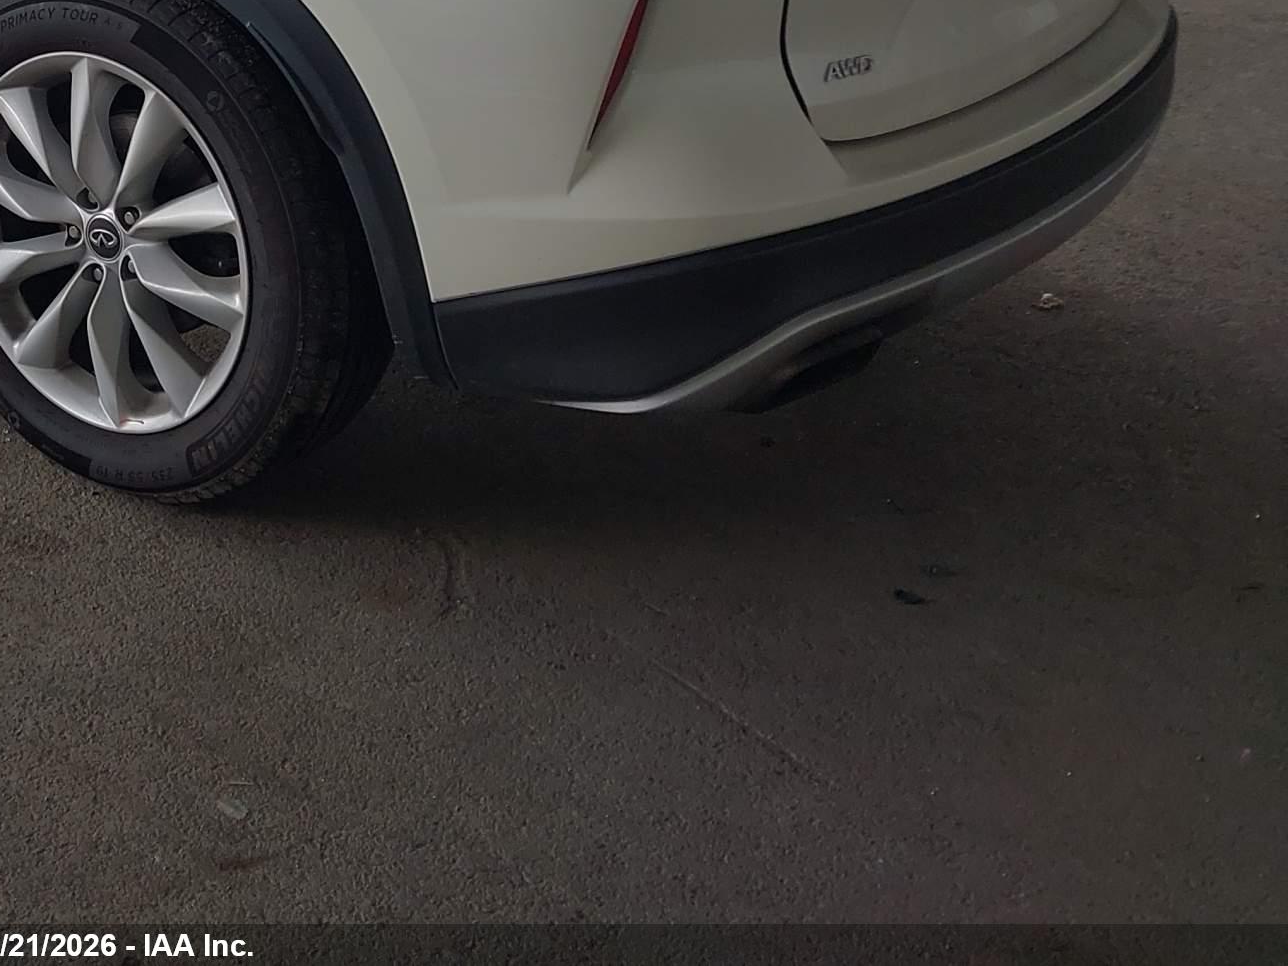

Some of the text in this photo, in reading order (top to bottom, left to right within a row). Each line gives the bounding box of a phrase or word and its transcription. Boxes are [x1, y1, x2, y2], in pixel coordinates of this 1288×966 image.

[0, 8, 55, 34] PRIMACY
[61, 7, 98, 25] TOUR
[823, 54, 873, 83] AWD
